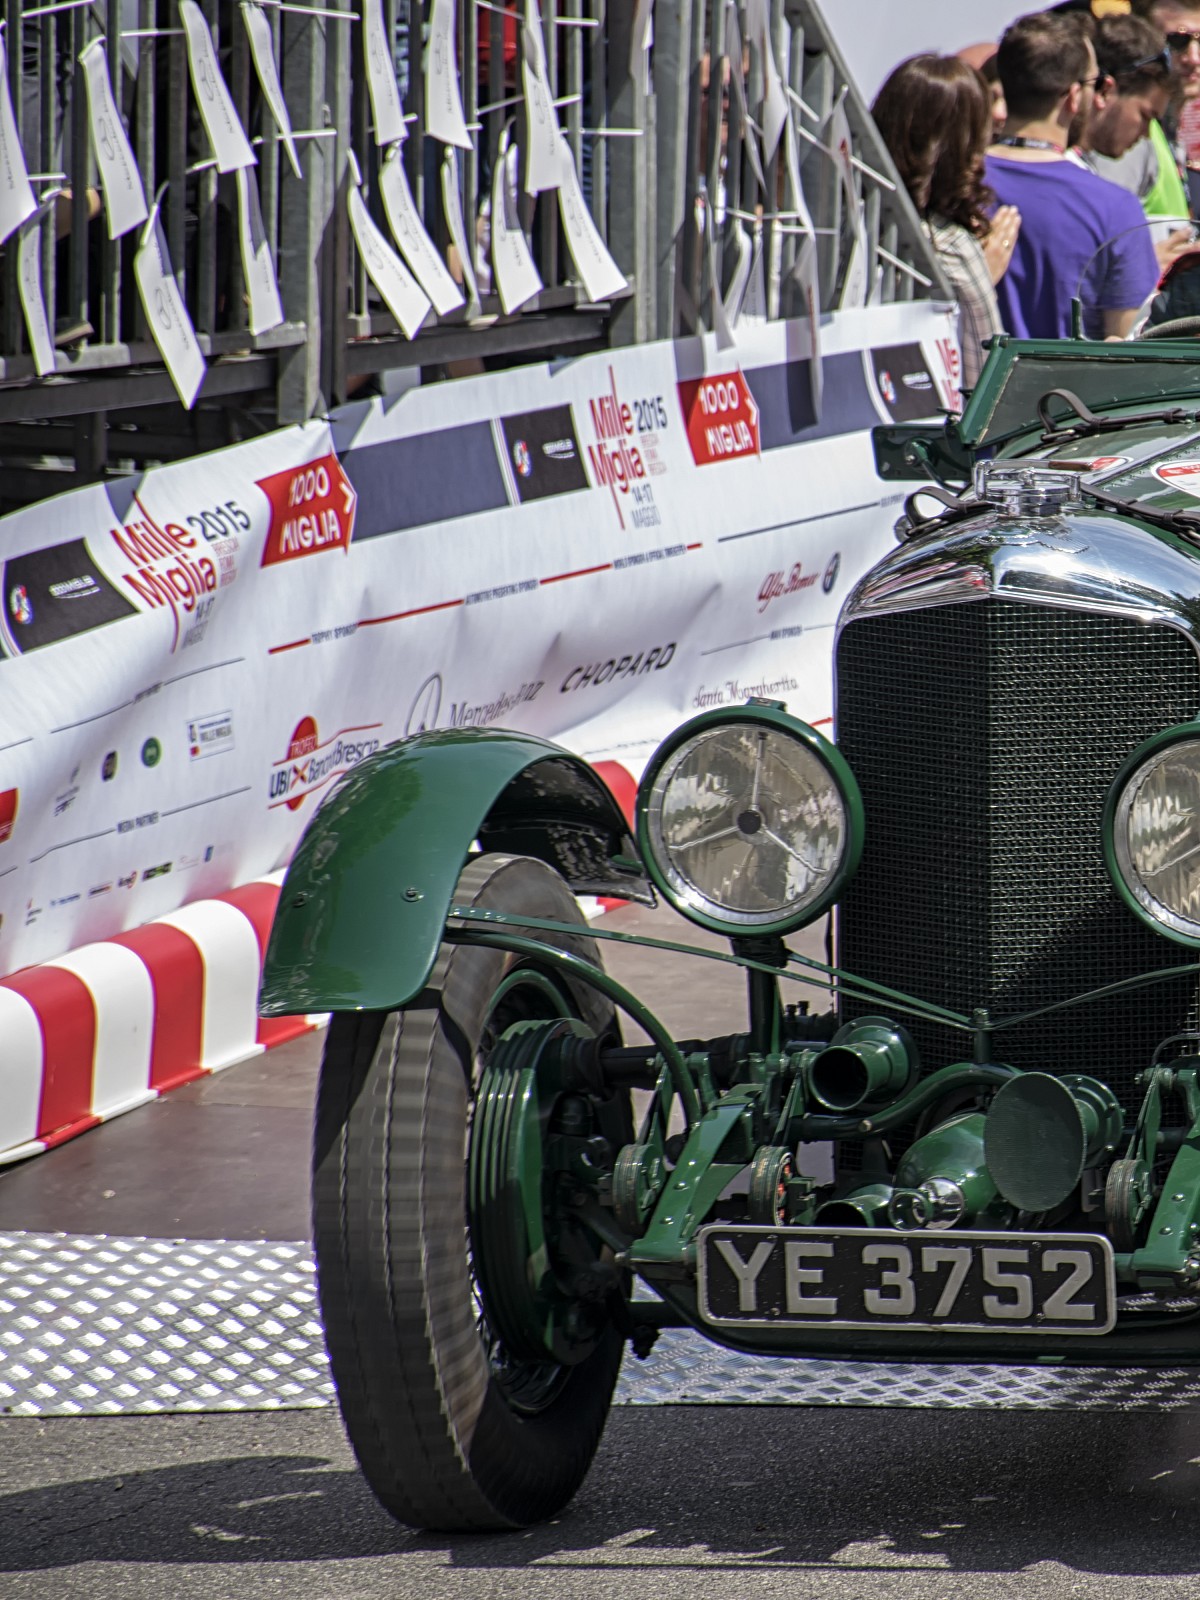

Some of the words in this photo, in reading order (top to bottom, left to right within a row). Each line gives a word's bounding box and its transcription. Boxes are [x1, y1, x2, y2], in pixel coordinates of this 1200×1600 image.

[589, 366, 634, 440] Mille
[634, 397, 667, 433] 2015
[699, 380, 739, 415] 1000
[704, 420, 753, 456] MIGLIA
[289, 467, 330, 507] 1000
[110, 490, 197, 567] Mille
[186, 501, 251, 542] 2015
[280, 509, 341, 554] MIGLIA
[757, 571, 785, 614] Alfa
[560, 642, 677, 693] CHOPARD
[692, 683, 724, 709] Santa
[270, 768, 292, 799] UBI
[713, 1240, 838, 1315] YE
[862, 1243, 1095, 1321] 3752
